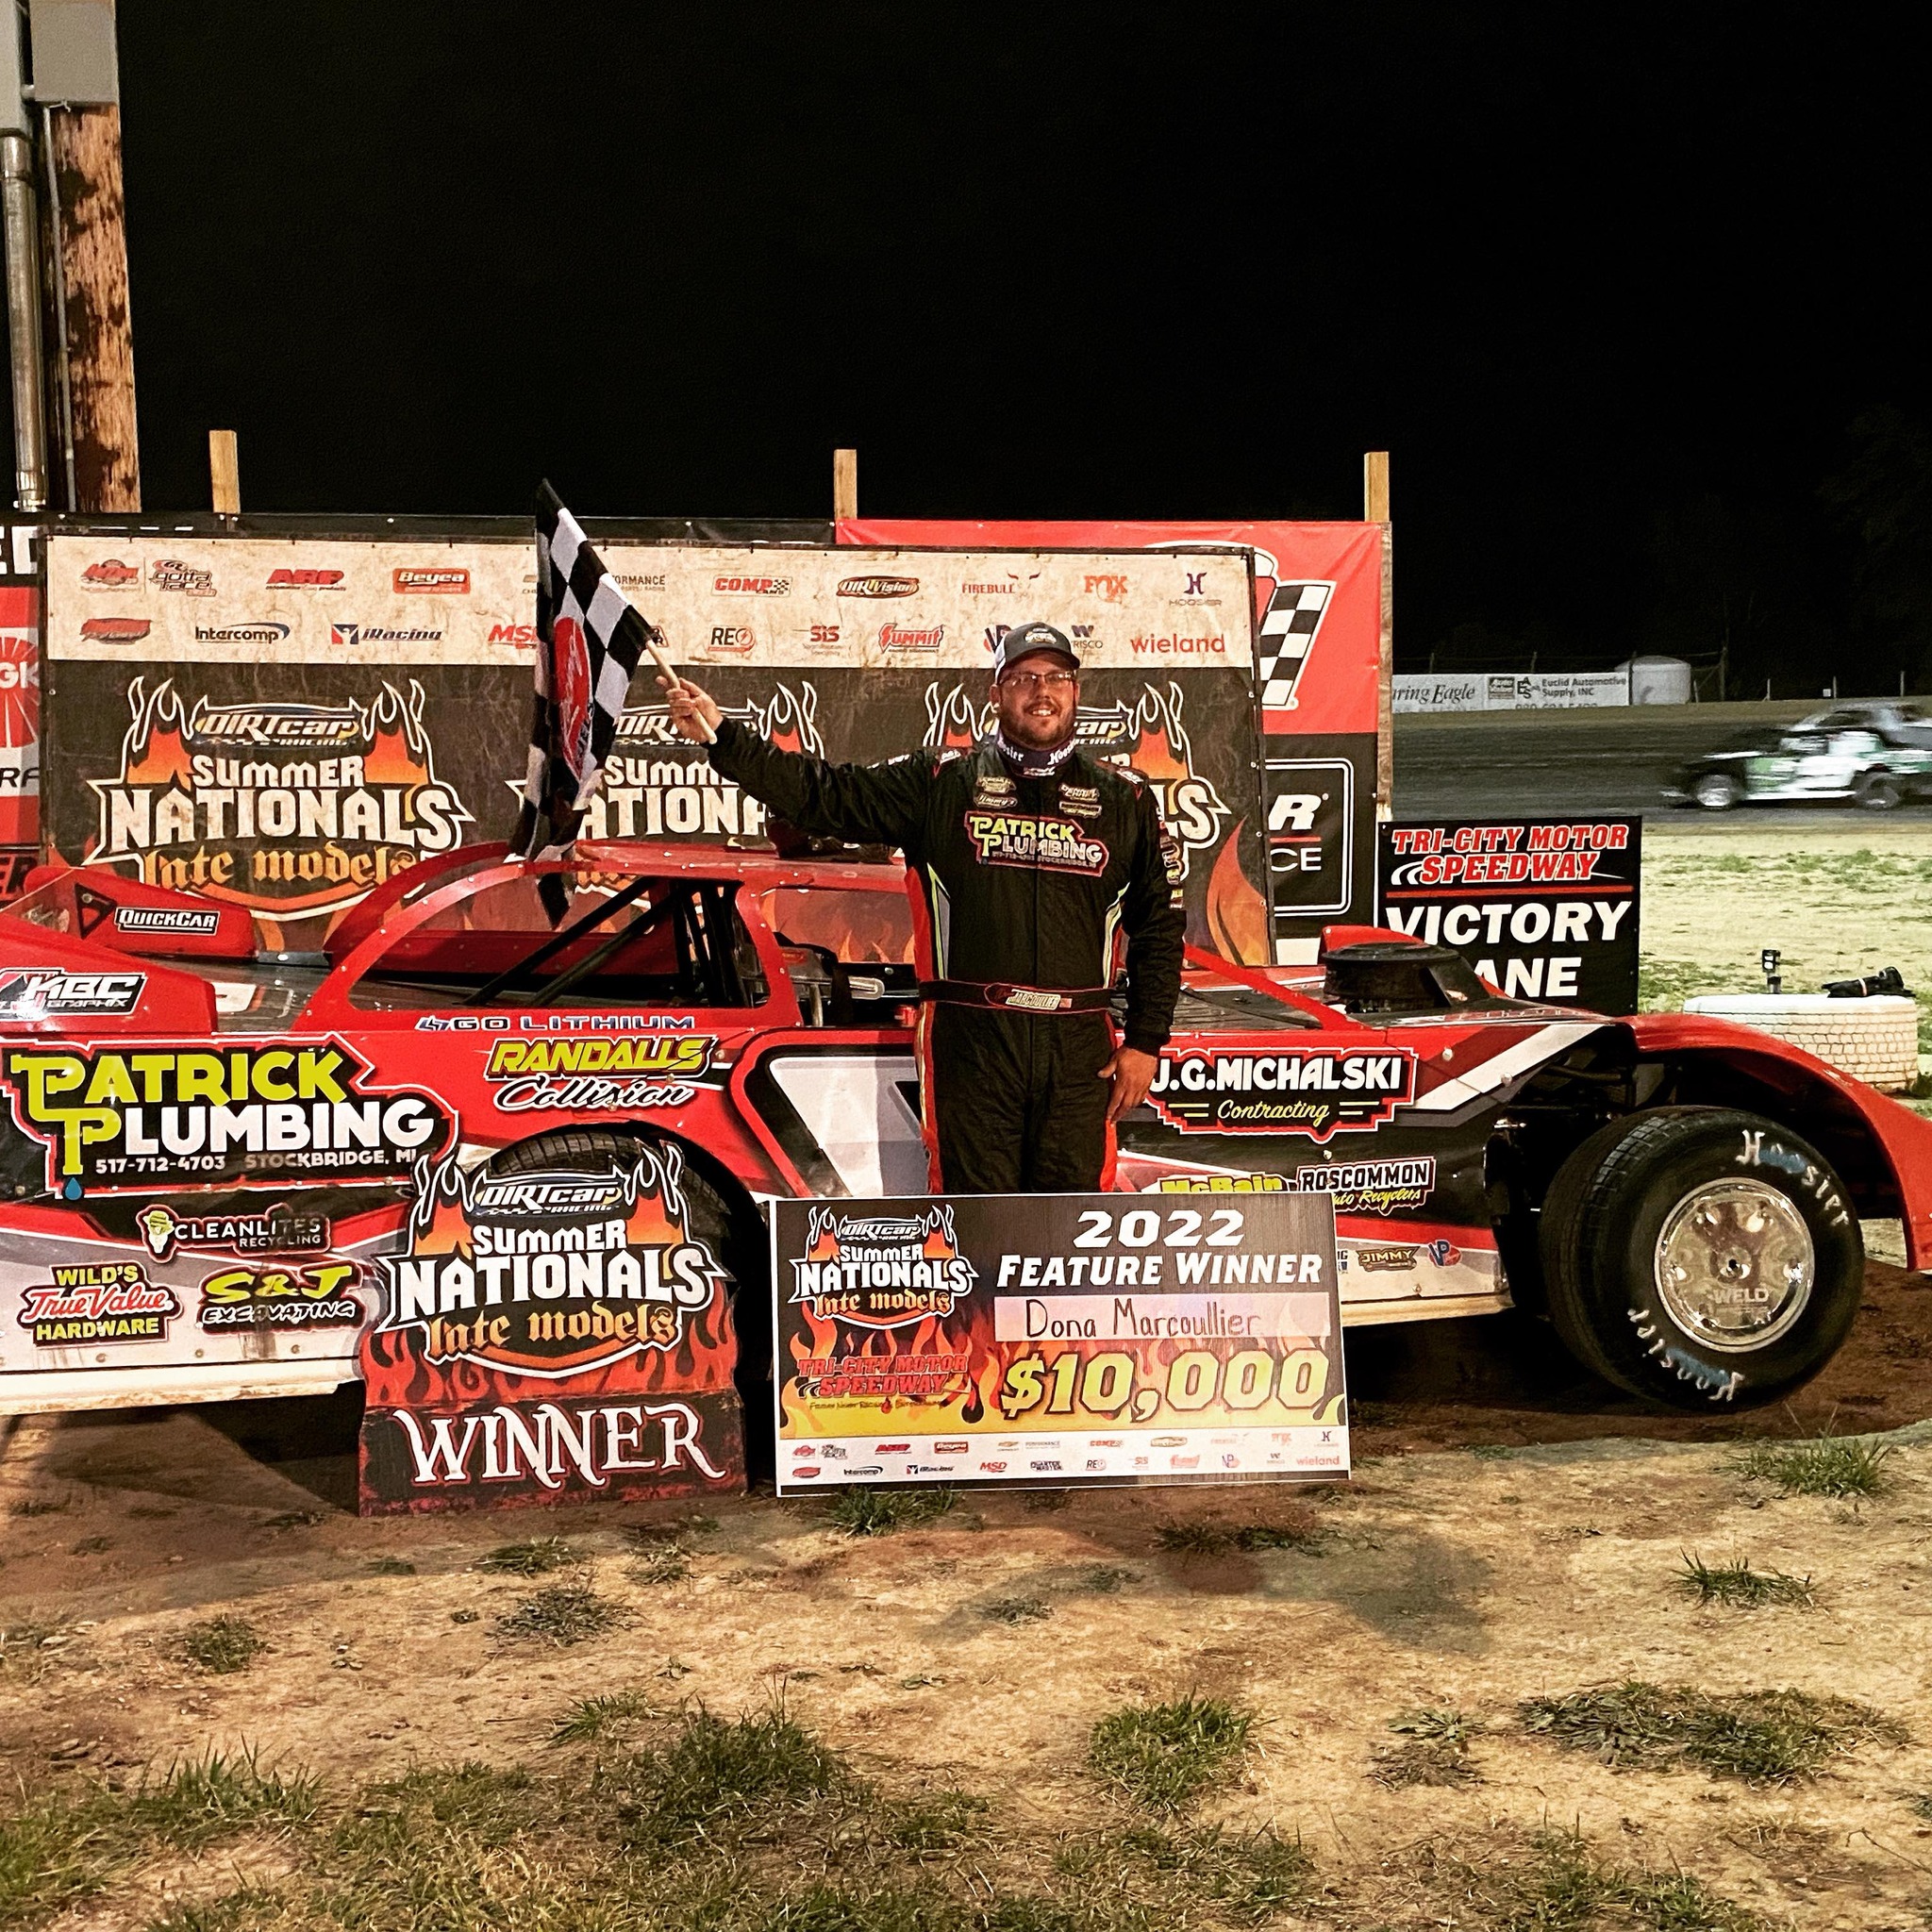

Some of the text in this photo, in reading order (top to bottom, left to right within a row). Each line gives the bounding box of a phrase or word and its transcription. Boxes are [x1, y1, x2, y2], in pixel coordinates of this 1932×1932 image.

[612, 575, 666, 585] ORMANCE
[713, 577, 774, 591] COMP
[961, 583, 1015, 593] FIREBULL
[195, 625, 279, 644] Intercomp
[362, 627, 442, 641] iRacing
[488, 624, 537, 642] MS
[1130, 633, 1225, 654] wieland
[1430, 683, 1475, 705] Eagle
[1541, 676, 1627, 687] Euclid Automotive
[1577, 688, 1595, 696] INC
[109, 786, 453, 851] NATIONALS
[576, 785, 768, 841] ATIONA
[970, 815, 1075, 841] PATRICK
[1391, 824, 1629, 856] TRI-CITY MOTOR
[981, 832, 1103, 862] PLUMBING
[1419, 851, 1600, 885] SPEEDWAY
[119, 908, 216, 928] QUICKCAR
[1386, 901, 1632, 946] VICTORY
[24, 975, 141, 1000] KBC
[1475, 957, 1582, 998] ANE
[519, 1015, 695, 1030] LITHIUM
[491, 1038, 708, 1073] RANDALLS
[11, 1050, 347, 1113] PATRICK
[495, 1074, 695, 1111] Collision
[1217, 1099, 1330, 1127] Contracting
[62, 1098, 435, 1174] PLUMBING
[95, 1155, 226, 1174] 517-712-4703
[1301, 1165, 1427, 1191] ROSCOMMON
[478, 1183, 619, 1208] DIRTcar
[1332, 1189, 1421, 1210] uto Recyclers
[174, 1217, 322, 1241] CLEANLITES
[1073, 1208, 1246, 1249] 2022
[239, 1234, 322, 1249] RECYCLING
[1361, 1249, 1412, 1264] JIMMY
[56, 1264, 140, 1287] WILD'S
[799, 1258, 968, 1298] NATIONALS
[996, 1253, 1164, 1288] FEATURE
[1175, 1251, 1324, 1286] WINNER
[205, 1264, 354, 1304] S&J
[397, 1247, 708, 1322] NATIONALS
[1711, 1287, 1770, 1304] WELD
[201, 1302, 357, 1326] EXCAVATING
[816, 1288, 951, 1318] late models
[36, 1316, 160, 1341] HARDWARE
[425, 1299, 677, 1361] late models
[1025, 1298, 1097, 1339] Dona
[797, 1354, 969, 1377] TRI-CITY MOTOR
[817, 1374, 949, 1397] SPEEDWAY
[1000, 1348, 1331, 1423] $10,000
[391, 1403, 727, 1491] WINNER
[843, 1468, 879, 1476] Intercomp
[979, 1461, 1008, 1473] MSD
[1296, 1455, 1341, 1466] wieland
